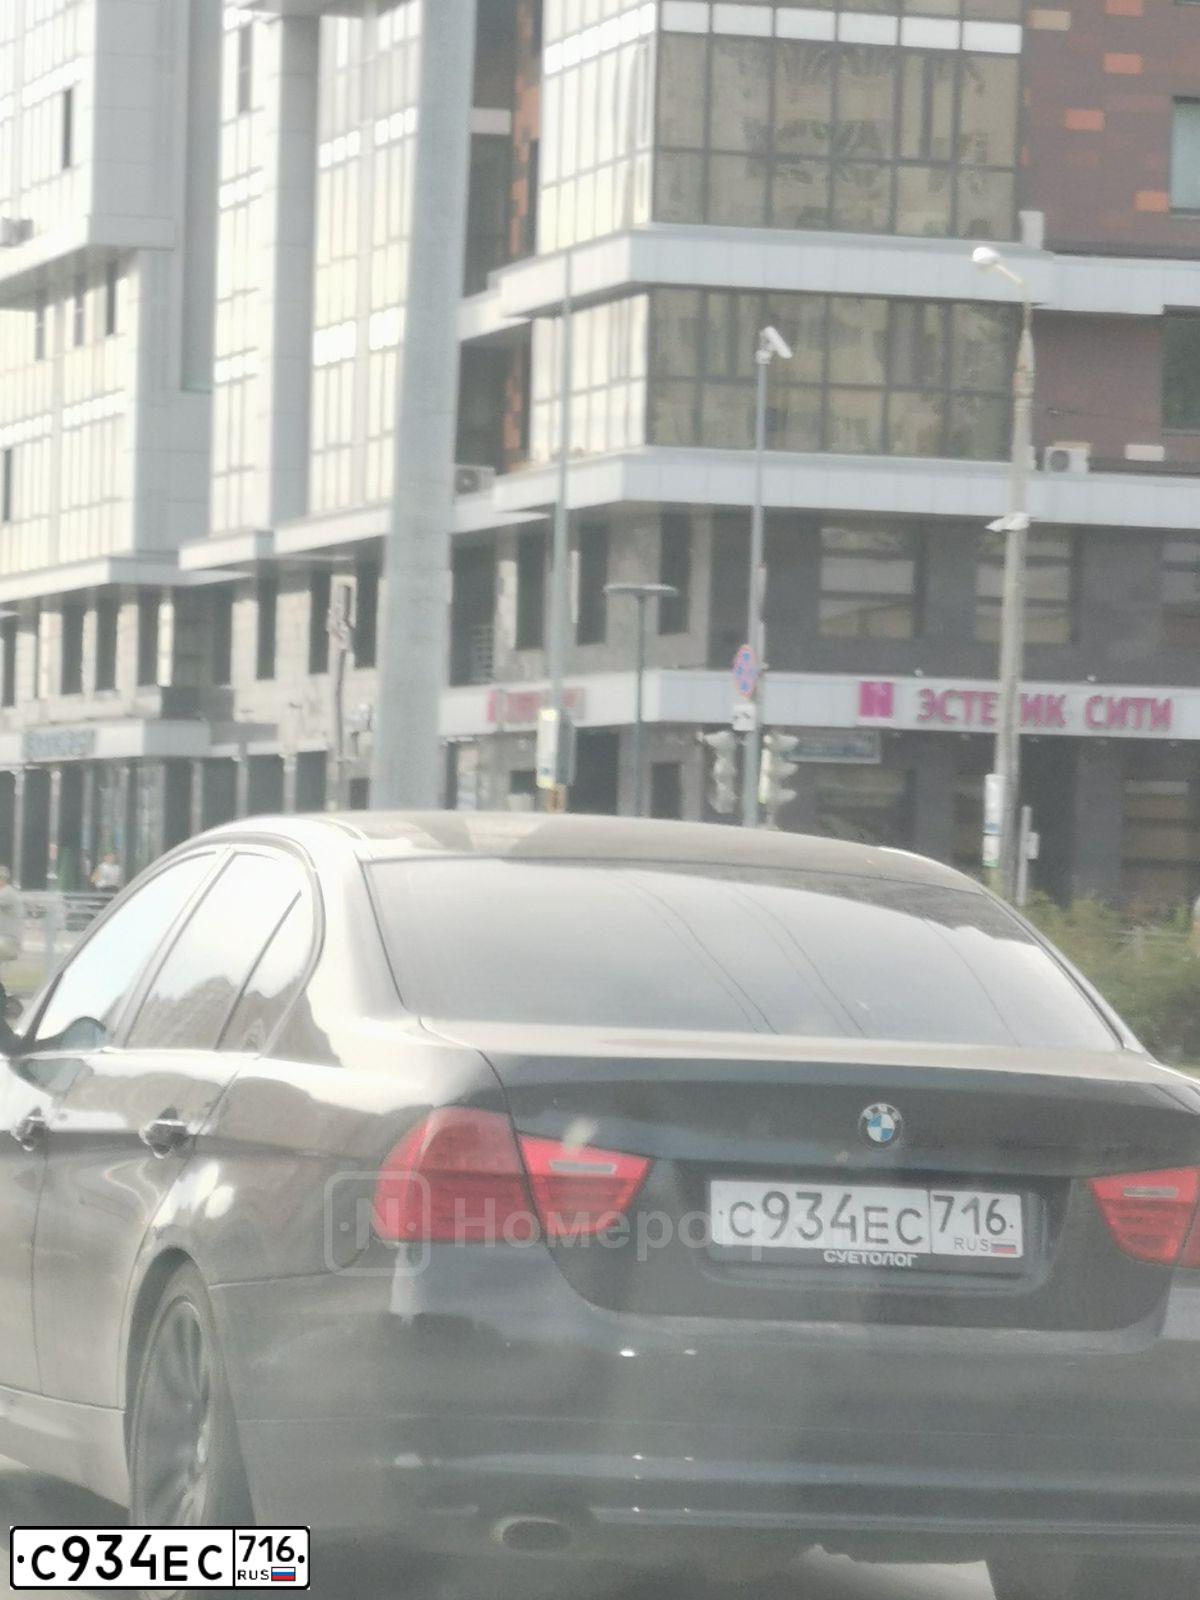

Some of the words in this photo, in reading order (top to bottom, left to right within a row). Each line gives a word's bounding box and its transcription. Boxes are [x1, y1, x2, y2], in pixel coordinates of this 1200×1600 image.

[917, 687, 1067, 729] ЭСТЕИК
[1083, 694, 1174, 731] СИТИ
[729, 1190, 924, 1246] С934ЕС
[933, 1194, 1008, 1236] 716
[823, 1249, 918, 1268] СУЕТОЛОГ
[954, 1237, 990, 1252] RUS
